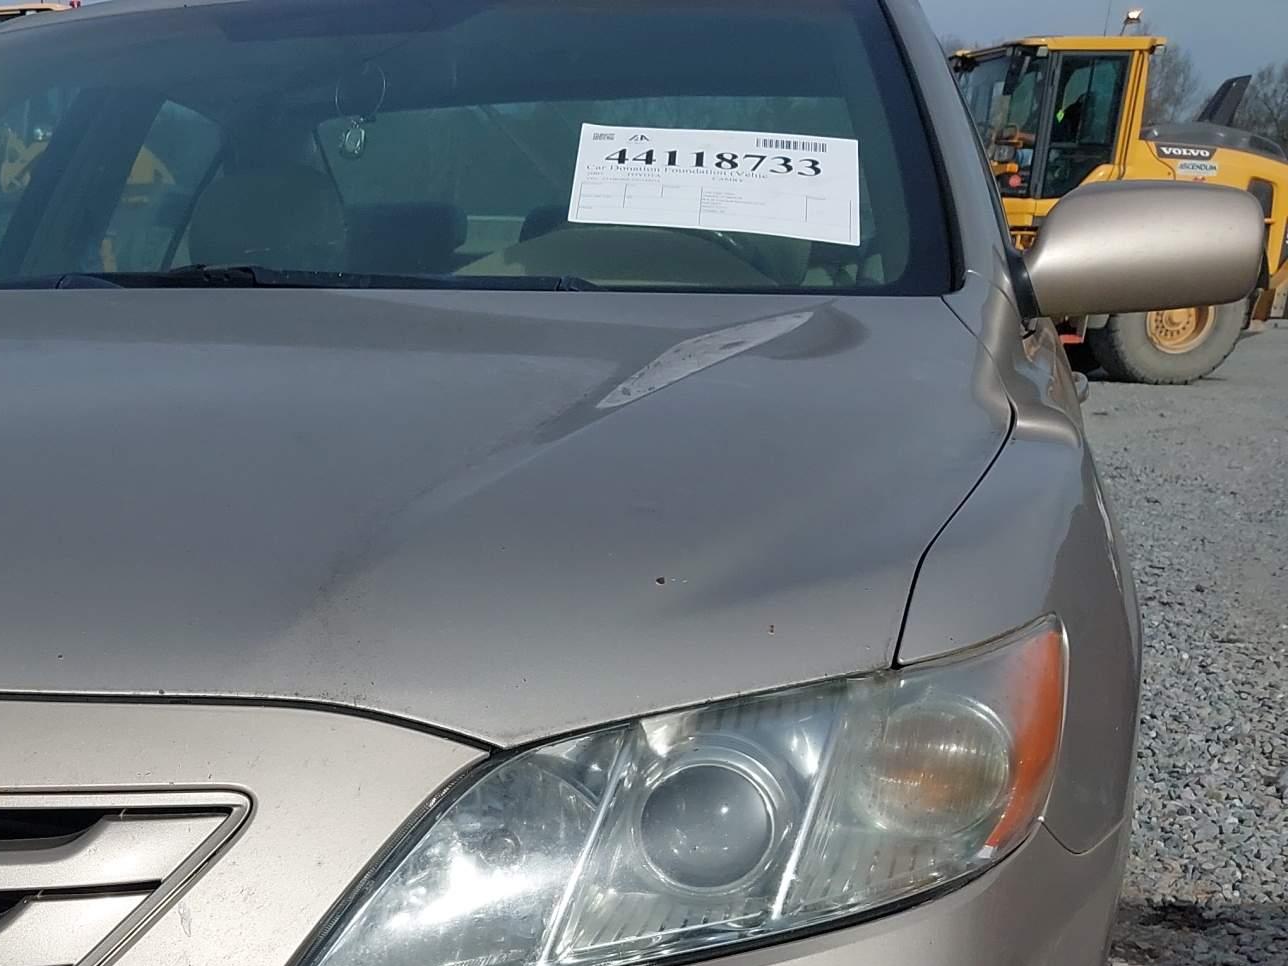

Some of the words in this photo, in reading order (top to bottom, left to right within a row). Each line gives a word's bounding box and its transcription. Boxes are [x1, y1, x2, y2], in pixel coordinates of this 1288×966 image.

[1159, 146, 1210, 157] VOLVO
[605, 148, 822, 176] 44118733
[609, 165, 660, 173] Donation
[664, 167, 727, 176] Foundation
